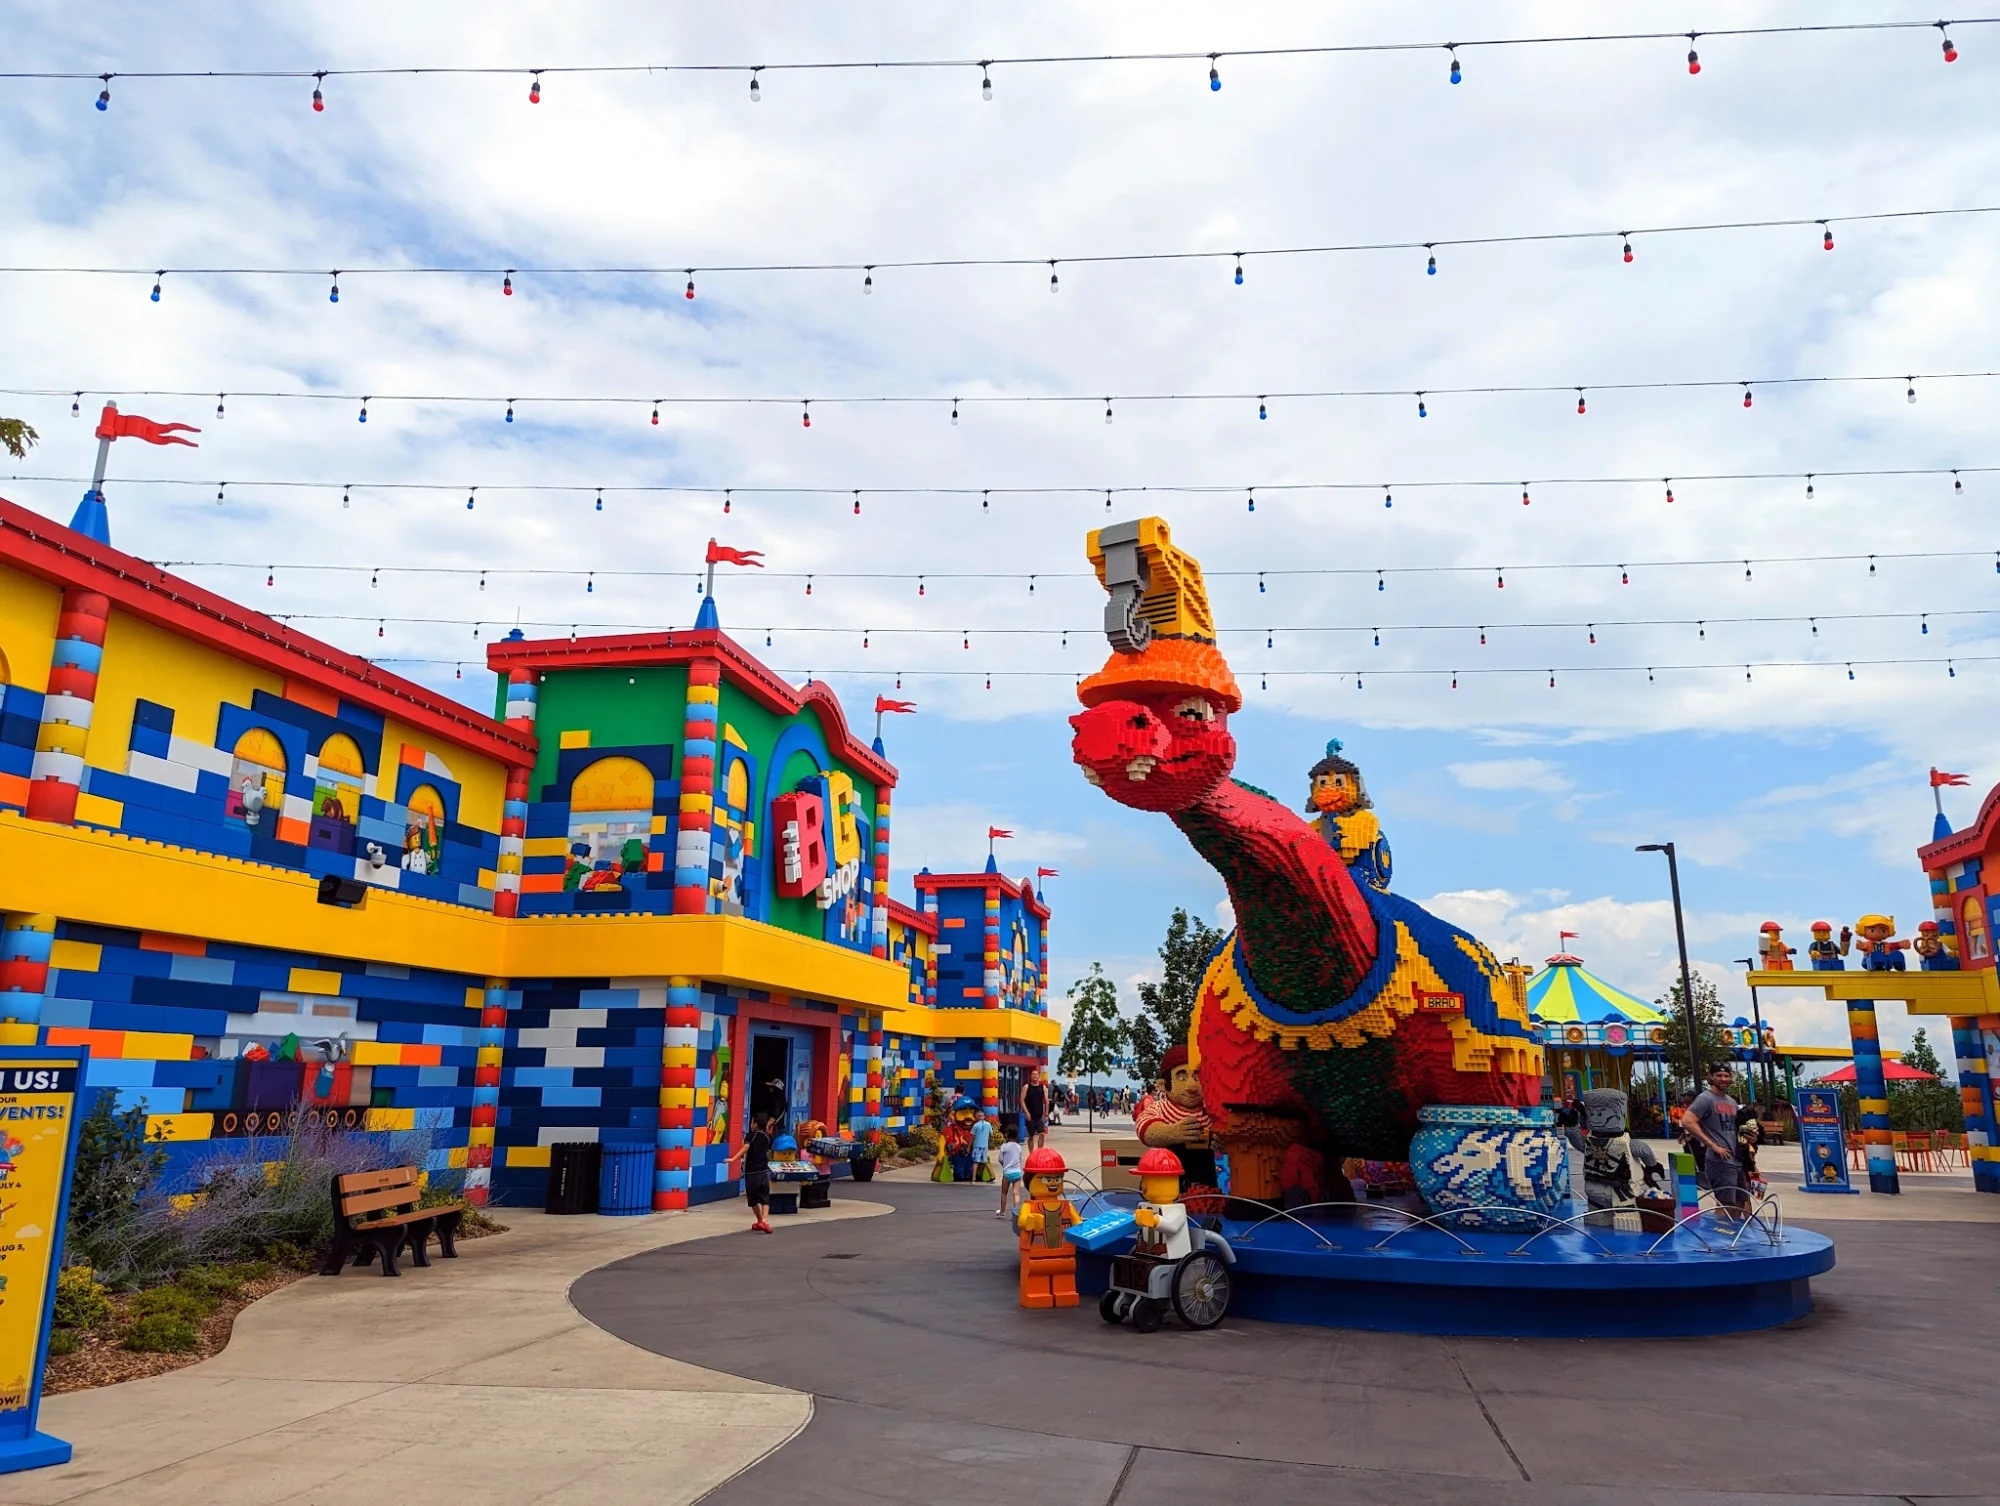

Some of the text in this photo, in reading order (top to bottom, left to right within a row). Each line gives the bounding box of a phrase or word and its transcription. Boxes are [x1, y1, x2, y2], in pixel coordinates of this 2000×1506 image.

[771, 769, 862, 898] BIG
[815, 857, 860, 911] SHOP
[1428, 997, 1456, 1008] BRAD
[14, 1071, 60, 1090] US!
[0, 1244, 16, 1252] UG
